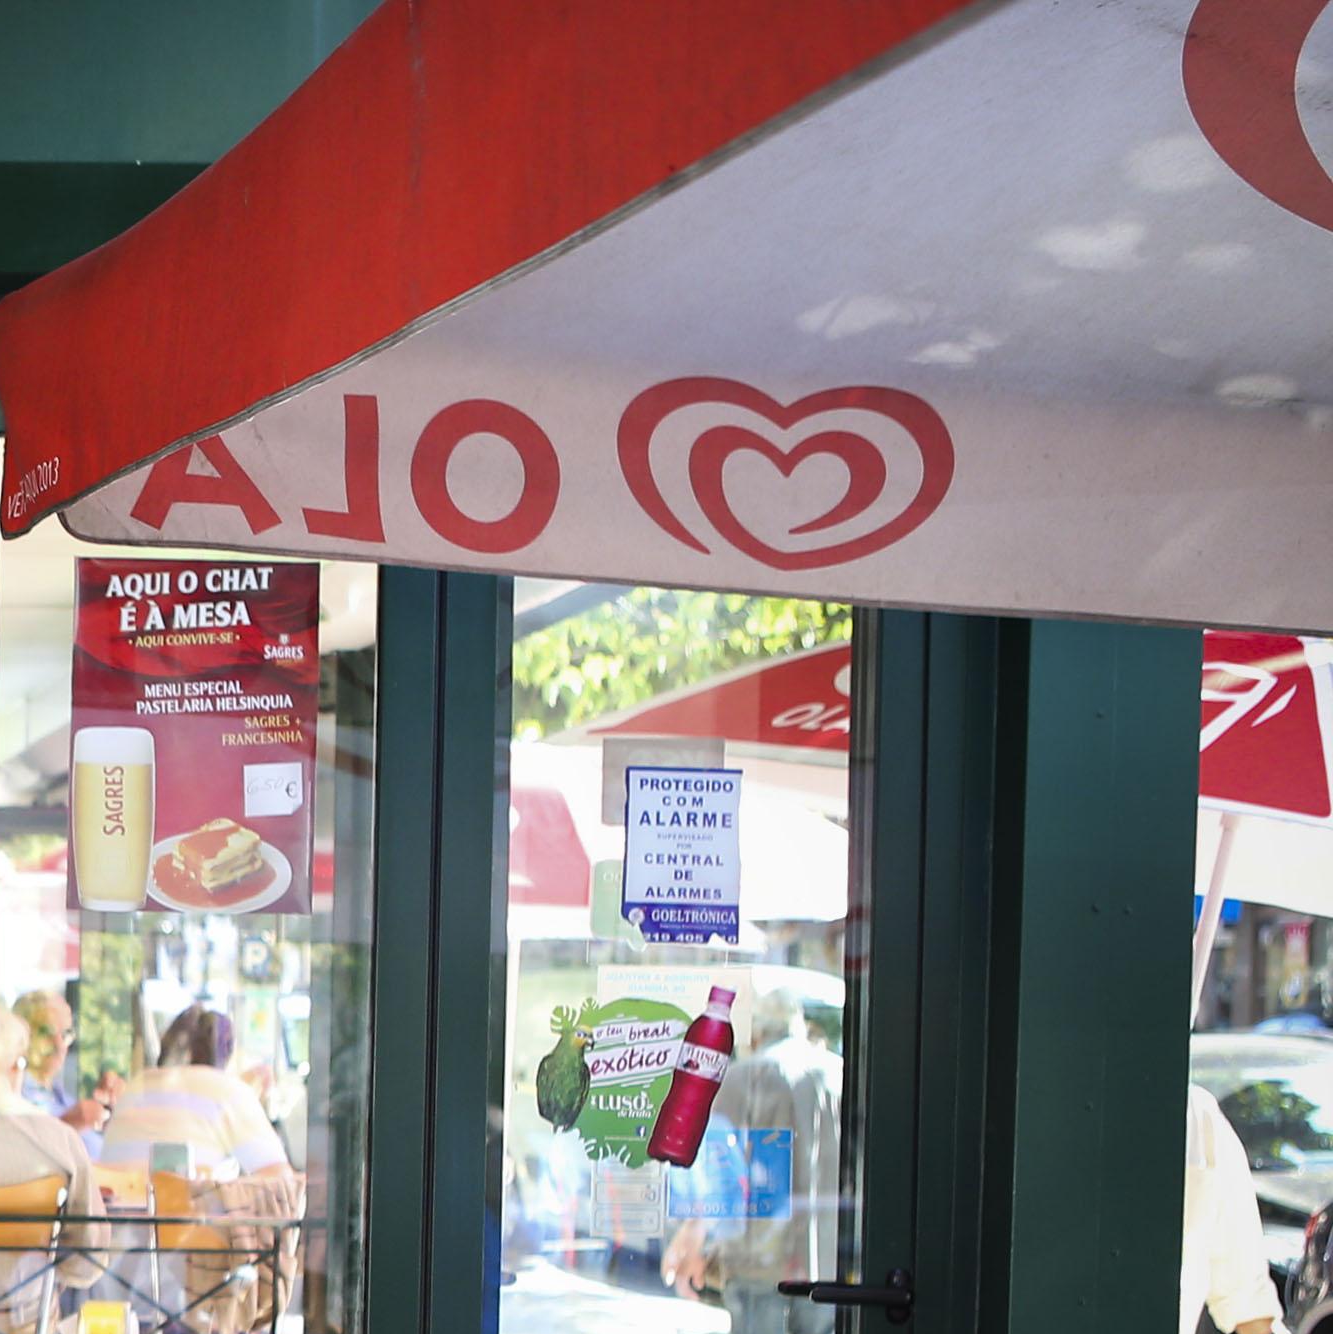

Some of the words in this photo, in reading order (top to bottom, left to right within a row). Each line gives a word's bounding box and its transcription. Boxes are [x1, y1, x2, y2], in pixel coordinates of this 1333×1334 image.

[37, 456, 60, 491] 2013
[106, 572, 170, 599] AQUI
[177, 570, 199, 594] O
[205, 567, 273, 593] CHAT
[120, 601, 137, 632] É
[143, 600, 165, 631] À
[173, 601, 251, 629] MESA
[135, 635, 165, 648] AQUI
[166, 632, 234, 646] CONVIVE-SE
[263, 645, 304, 660] SAGRES
[144, 683, 181, 698] MENU
[185, 680, 243, 696] ESPECIAL
[136, 698, 213, 715] PASTELARIA
[216, 695, 293, 714] HELSINQUIA
[244, 715, 290, 729] SAGRES
[222, 730, 303, 746] FRANCESINHA
[639, 778, 734, 793] PROTEGIDO
[103, 765, 125, 836] SAGRES
[662, 796, 704, 807] COM
[639, 810, 733, 829] ALARME
[644, 853, 724, 867] CENTRAL
[674, 869, 693, 881] DE
[645, 886, 722, 900] ALARMES
[651, 908, 736, 925] GOELTRÓNICA
[628, 1021, 671, 1042] break
[590, 1048, 672, 1076] exótico
